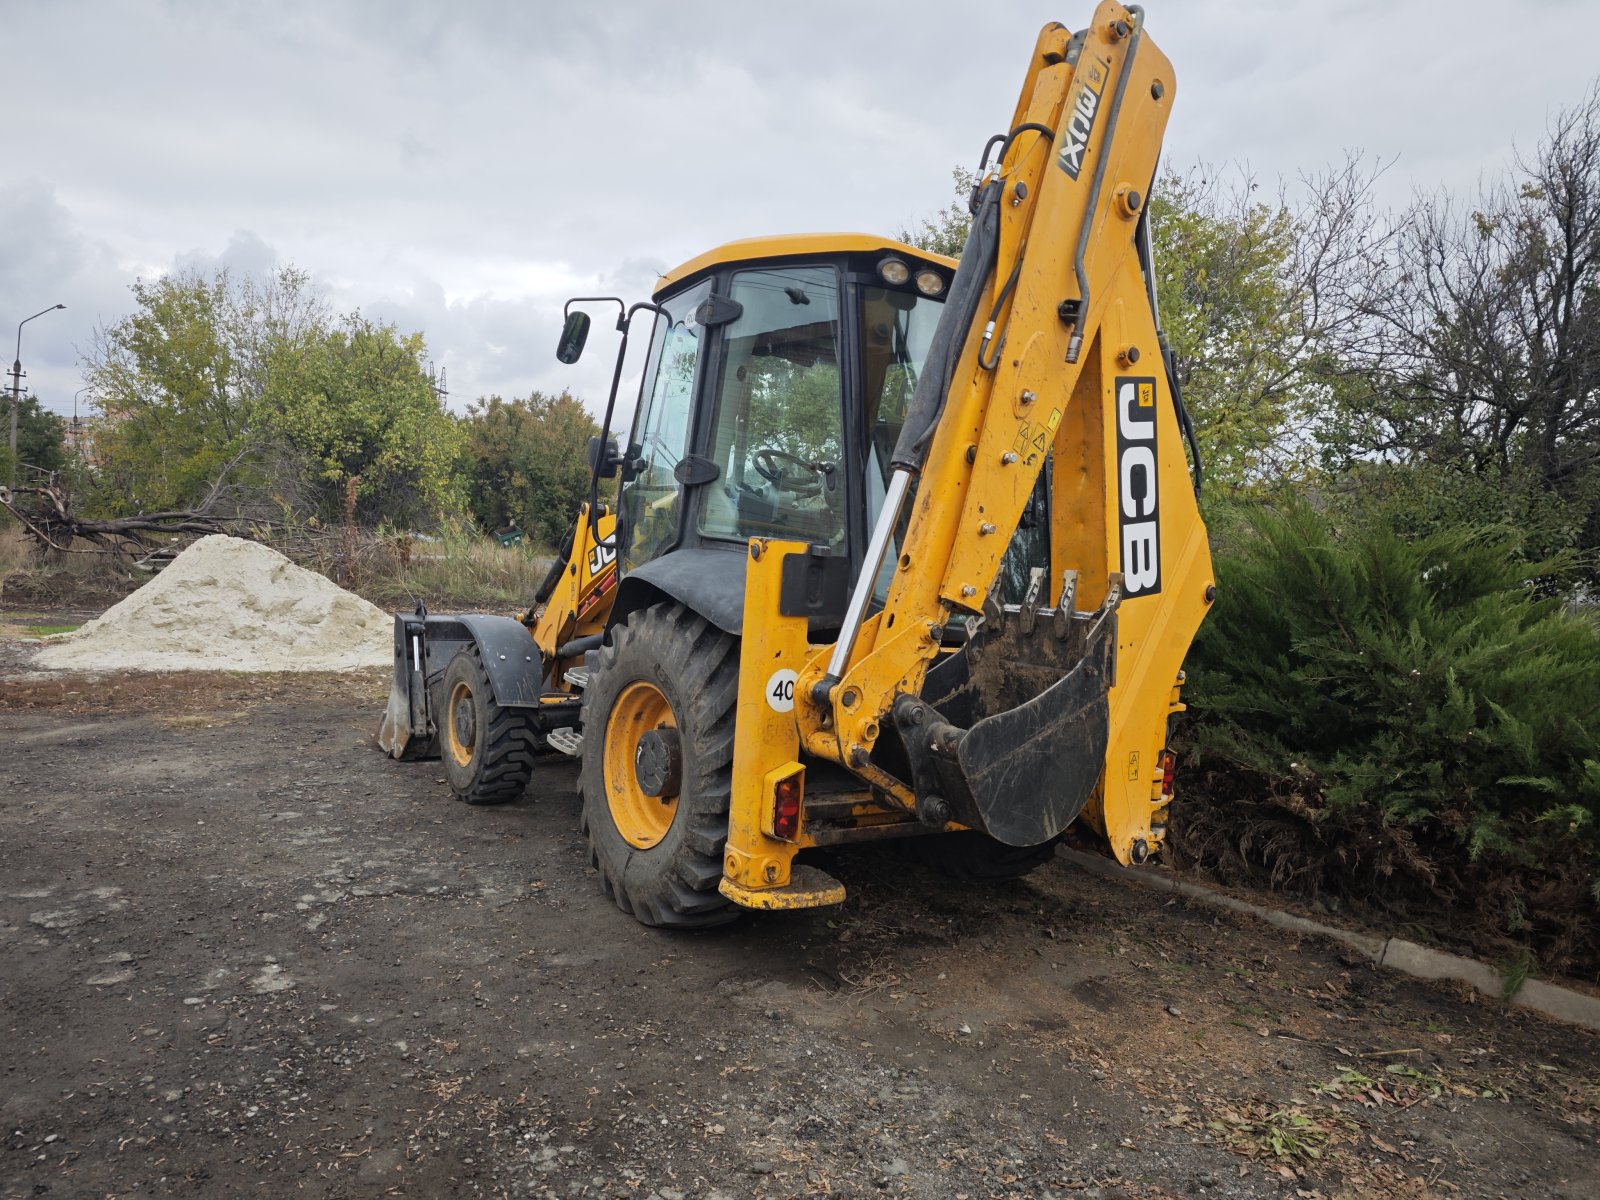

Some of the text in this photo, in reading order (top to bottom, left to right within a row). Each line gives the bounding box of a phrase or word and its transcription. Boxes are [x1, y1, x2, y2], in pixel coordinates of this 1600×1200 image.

[1119, 383, 1158, 593] JCB
[590, 534, 616, 574] JC
[773, 680, 794, 701] 40
